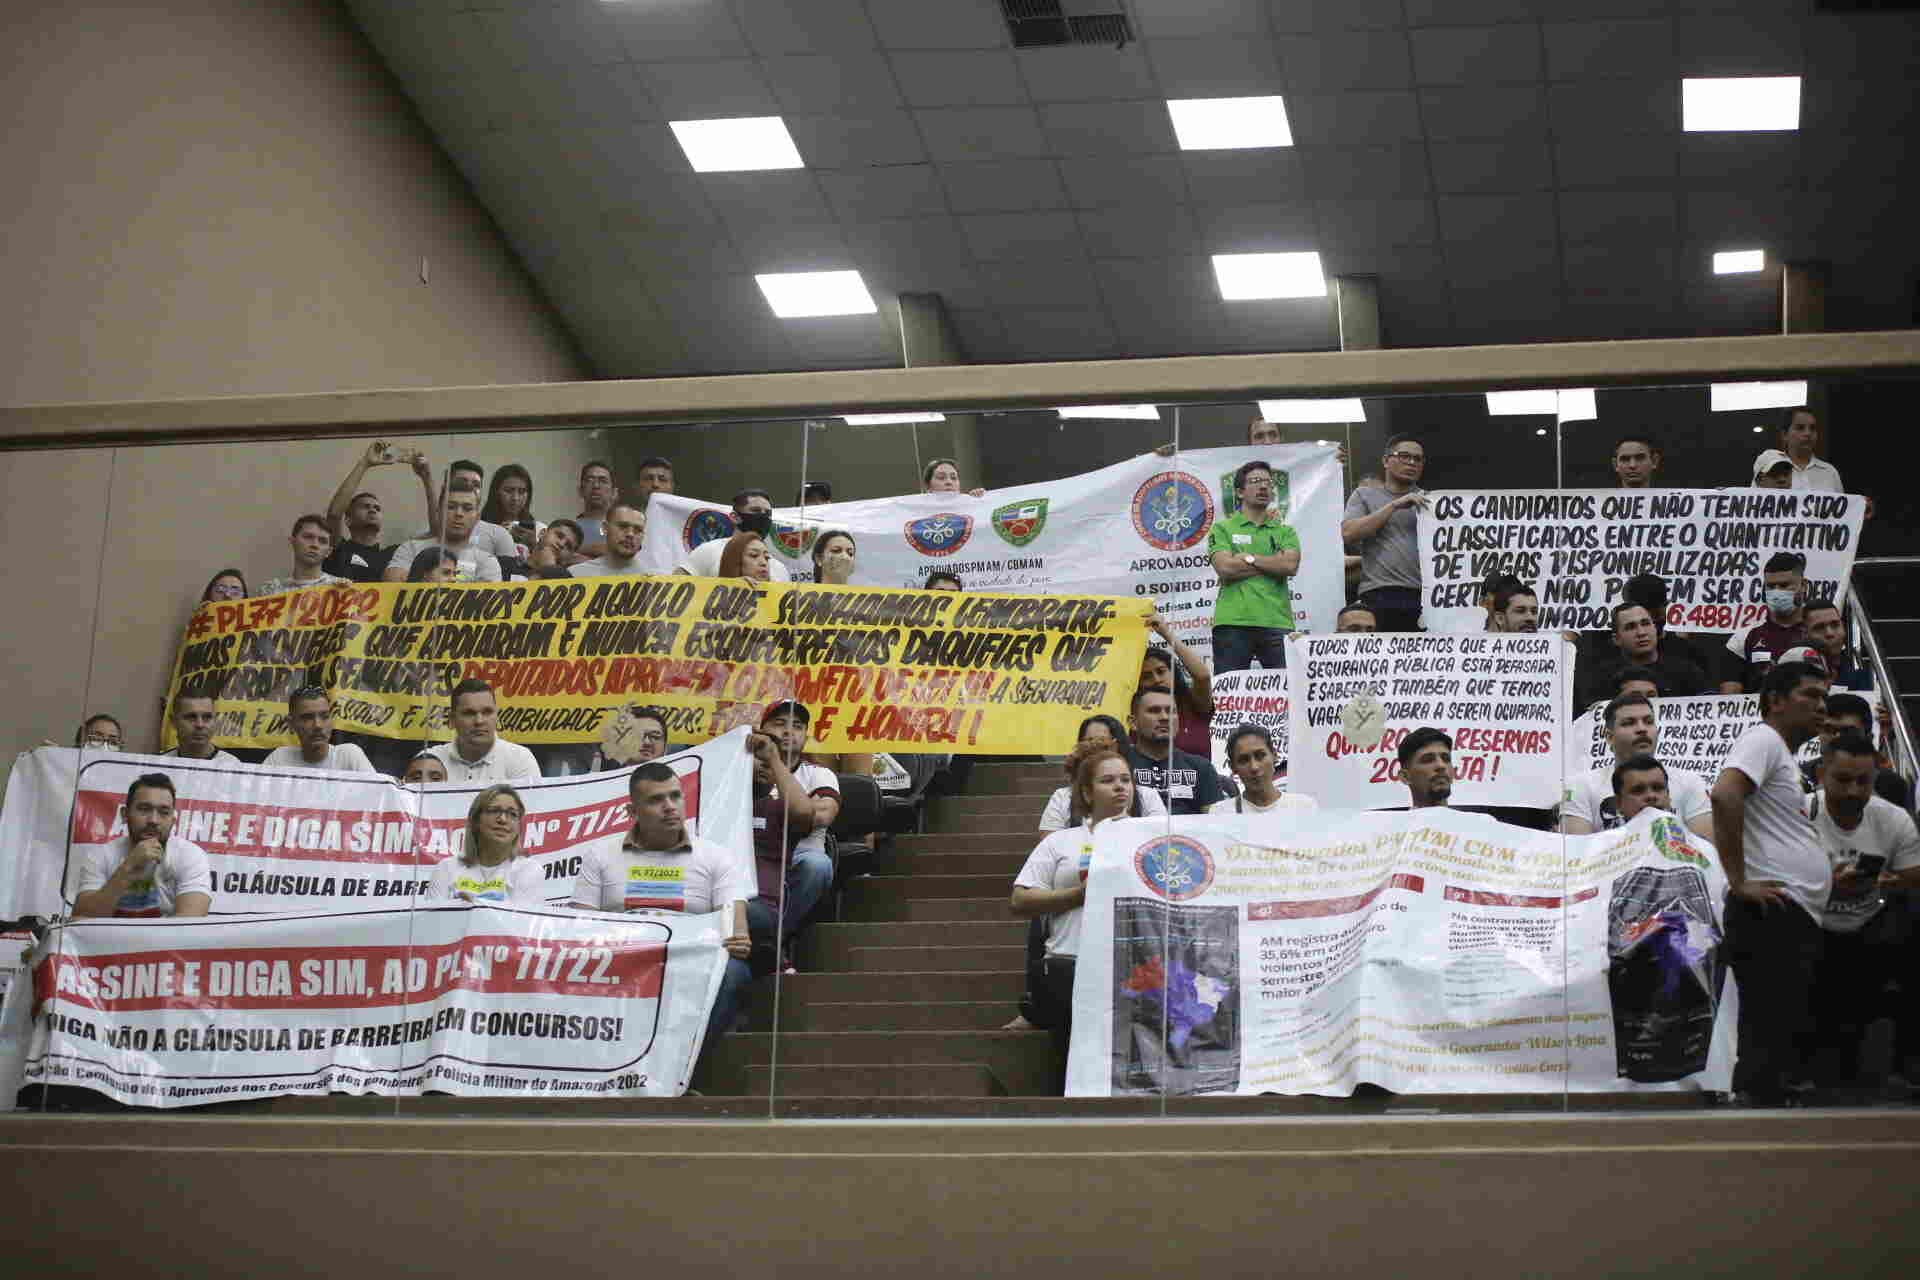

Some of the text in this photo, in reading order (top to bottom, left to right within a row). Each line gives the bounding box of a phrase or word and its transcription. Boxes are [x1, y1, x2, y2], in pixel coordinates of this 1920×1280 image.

[1434, 492, 1849, 521] OS CANDIDATOS QUE NÃO TENHAM SIDO
[1432, 521, 1851, 552] CLASSIFICADOS ENTRE O QUANTITATIVO
[1432, 549, 1760, 579] DE VAGAS DISPONIBILIZADAS
[524, 583, 587, 621] POR
[582, 581, 696, 620] AQUILO
[701, 583, 768, 623] QUE
[1543, 574, 1591, 605] NÃO
[1702, 578, 1745, 604] SER
[363, 624, 425, 659] QUE
[559, 621, 581, 658] E
[577, 621, 682, 658] NUNCA
[900, 631, 1048, 671] DAQUELES
[1050, 634, 1114, 673] QUE
[1308, 634, 1550, 656] TODOS NÓS SABEMOS QUE A NOSSA
[1306, 659, 1389, 679] SEGURANÇA
[1393, 655, 1456, 674] PÚBLICA
[1461, 655, 1494, 674] ESTÁ
[1307, 683, 1317, 701] E
[1391, 676, 1460, 696] TAMBÉM
[1465, 677, 1496, 696] QUE
[1501, 680, 1552, 698] TEMOS
[1433, 702, 1444, 720] A
[1446, 702, 1491, 721] SEREM
[1686, 701, 1713, 720] SER
[1453, 727, 1552, 754] RESERVAS
[1719, 723, 1742, 739] EU
[237, 814, 258, 846] E
[262, 816, 343, 852] DIGA
[223, 870, 336, 897] CLÁUSULA
[341, 878, 370, 897] DE
[56, 960, 176, 999] ASSINE
[183, 961, 201, 997] E
[208, 960, 293, 998] DIGA
[299, 958, 374, 998] SIM,
[381, 958, 428, 995] AO
[516, 945, 621, 985] 77/22.
[47, 1007, 624, 1053] DIGA NÃO A CLÁUSULA DE BARREIRA EM CONCURSOS!
